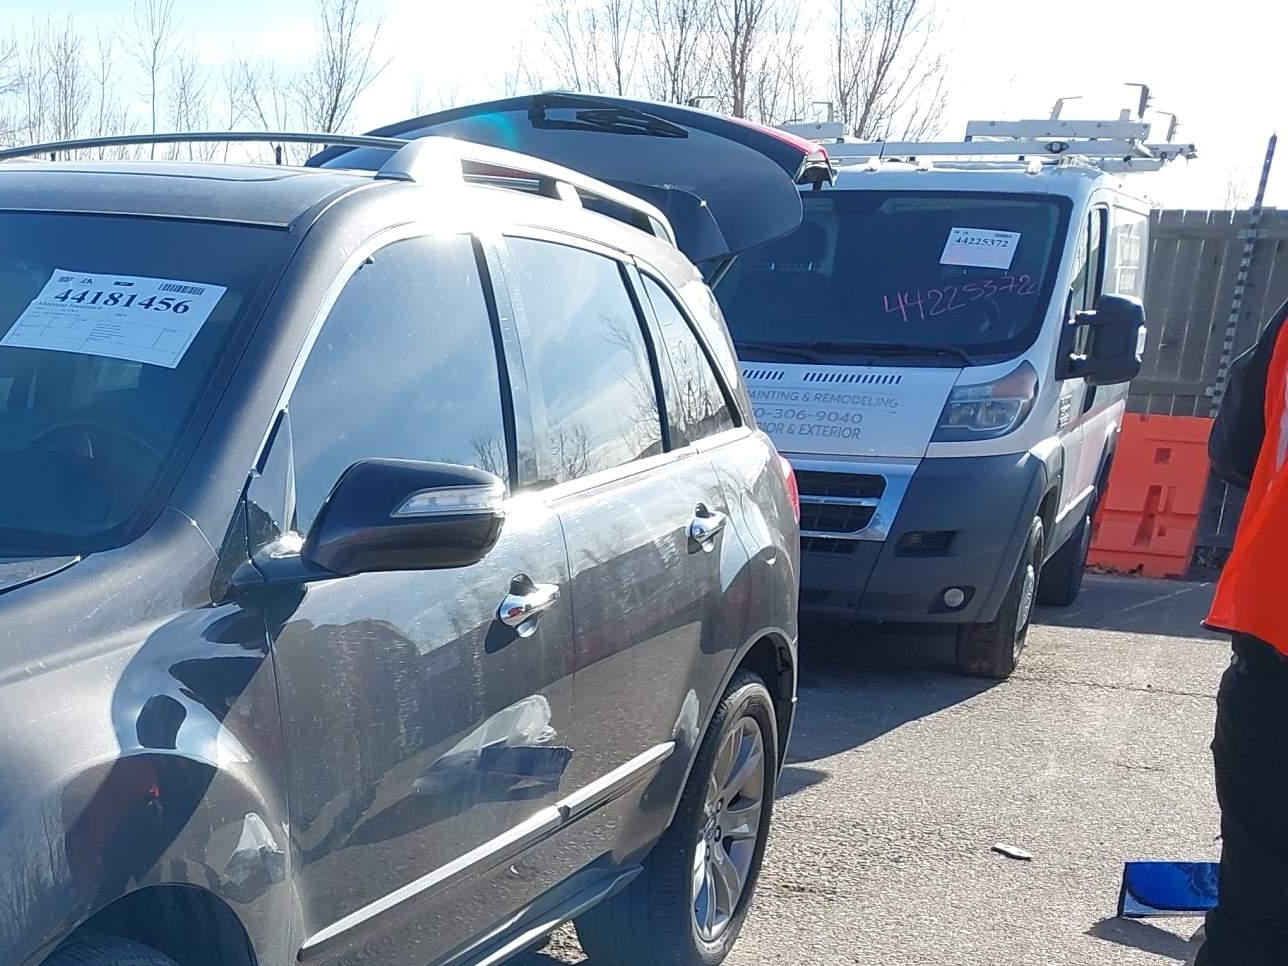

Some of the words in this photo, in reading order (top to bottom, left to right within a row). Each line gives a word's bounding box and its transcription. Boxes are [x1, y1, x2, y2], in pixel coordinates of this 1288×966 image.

[954, 236, 1009, 248] 44225372
[54, 288, 193, 314] 44181456
[801, 391, 810, 402] &
[813, 393, 899, 409] REMODELING
[752, 407, 863, 425] 0-306-9040
[786, 423, 795, 436] &
[798, 424, 861, 440] EXTERIOR
